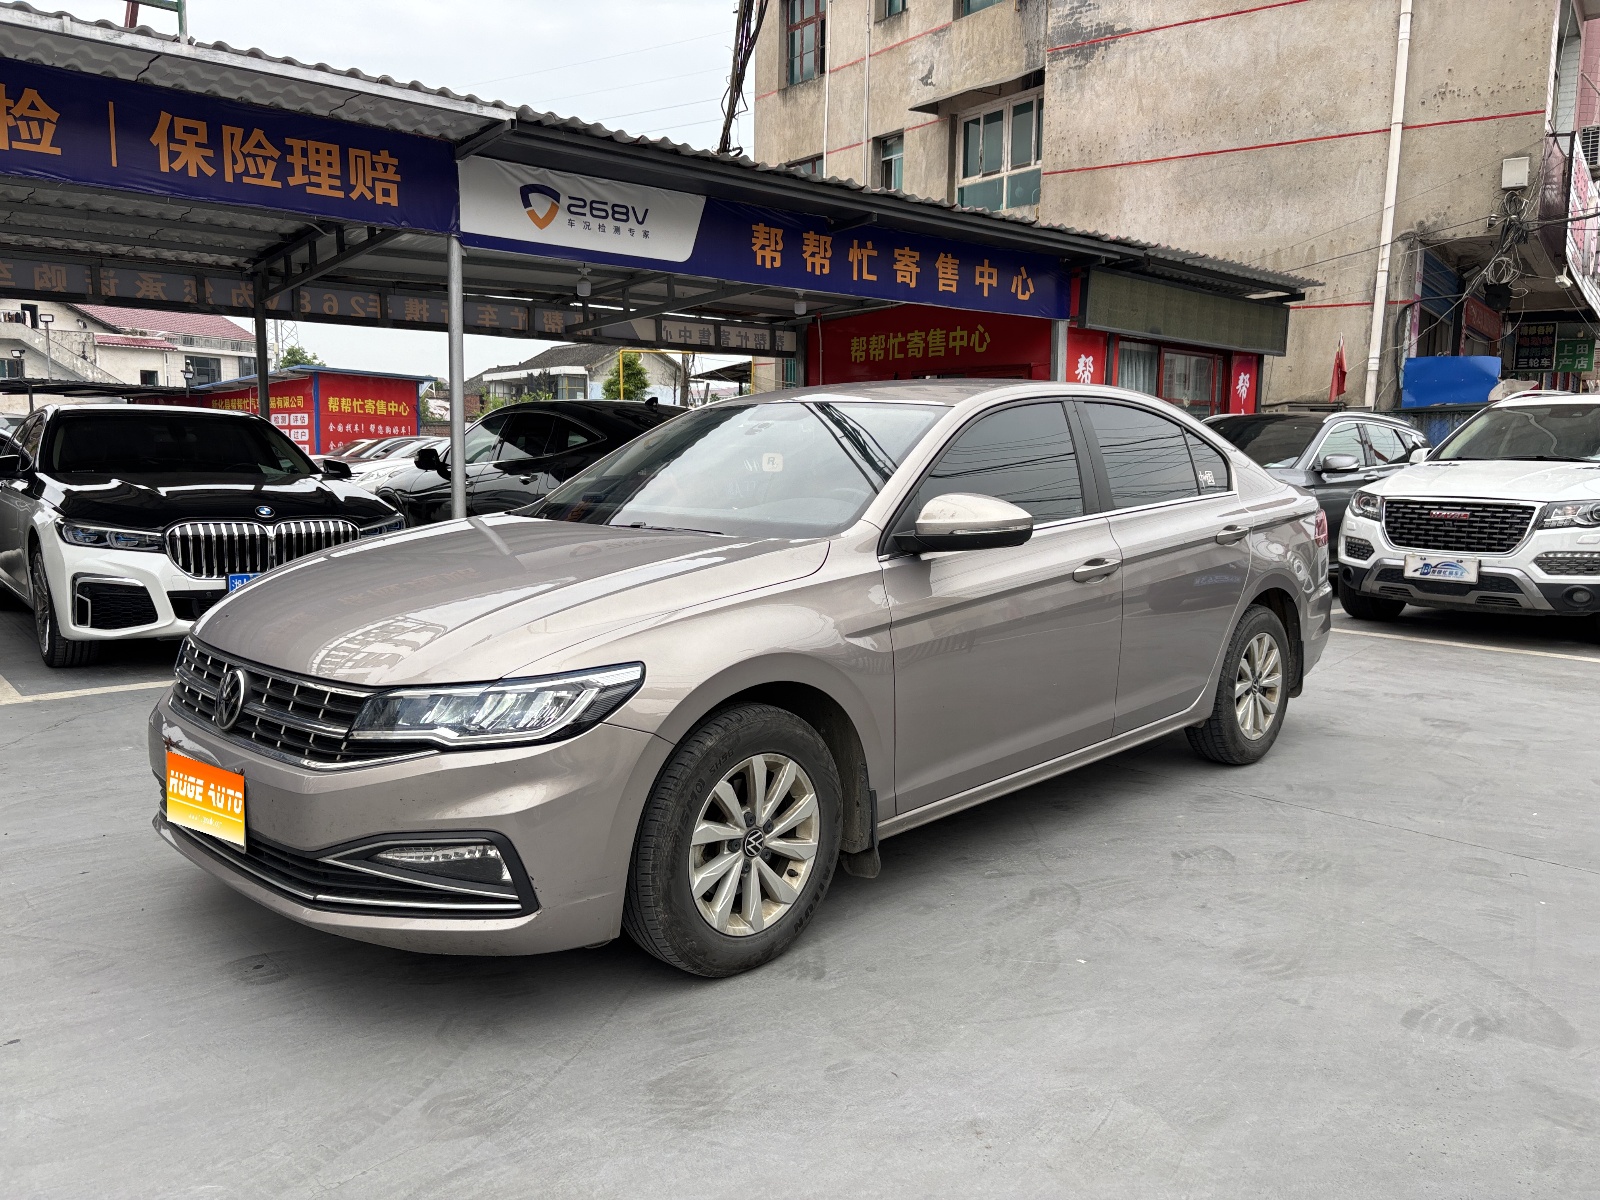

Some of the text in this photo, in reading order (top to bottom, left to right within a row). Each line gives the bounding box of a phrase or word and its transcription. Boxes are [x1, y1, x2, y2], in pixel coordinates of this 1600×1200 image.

[0, 84, 401, 207] 检 保险理赔
[567, 195, 649, 226] 268V
[567, 217, 650, 240] 车况检测专家
[751, 223, 1034, 301] 帮帮忙寄售中心
[850, 324, 991, 363] 帮帮忙寄售中心
[1517, 358, 1551, 368] 三轮车
[212, 395, 304, 410] 新化县帮帮忙汽易有限公司
[1236, 372, 1250, 414] 帮
[328, 396, 410, 416] 帮帮忙寄售中心
[273, 415, 287, 425] 检测
[293, 415, 306, 424] 评估
[294, 431, 307, 440] 过户
[232, 578, 247, 590] 湘
